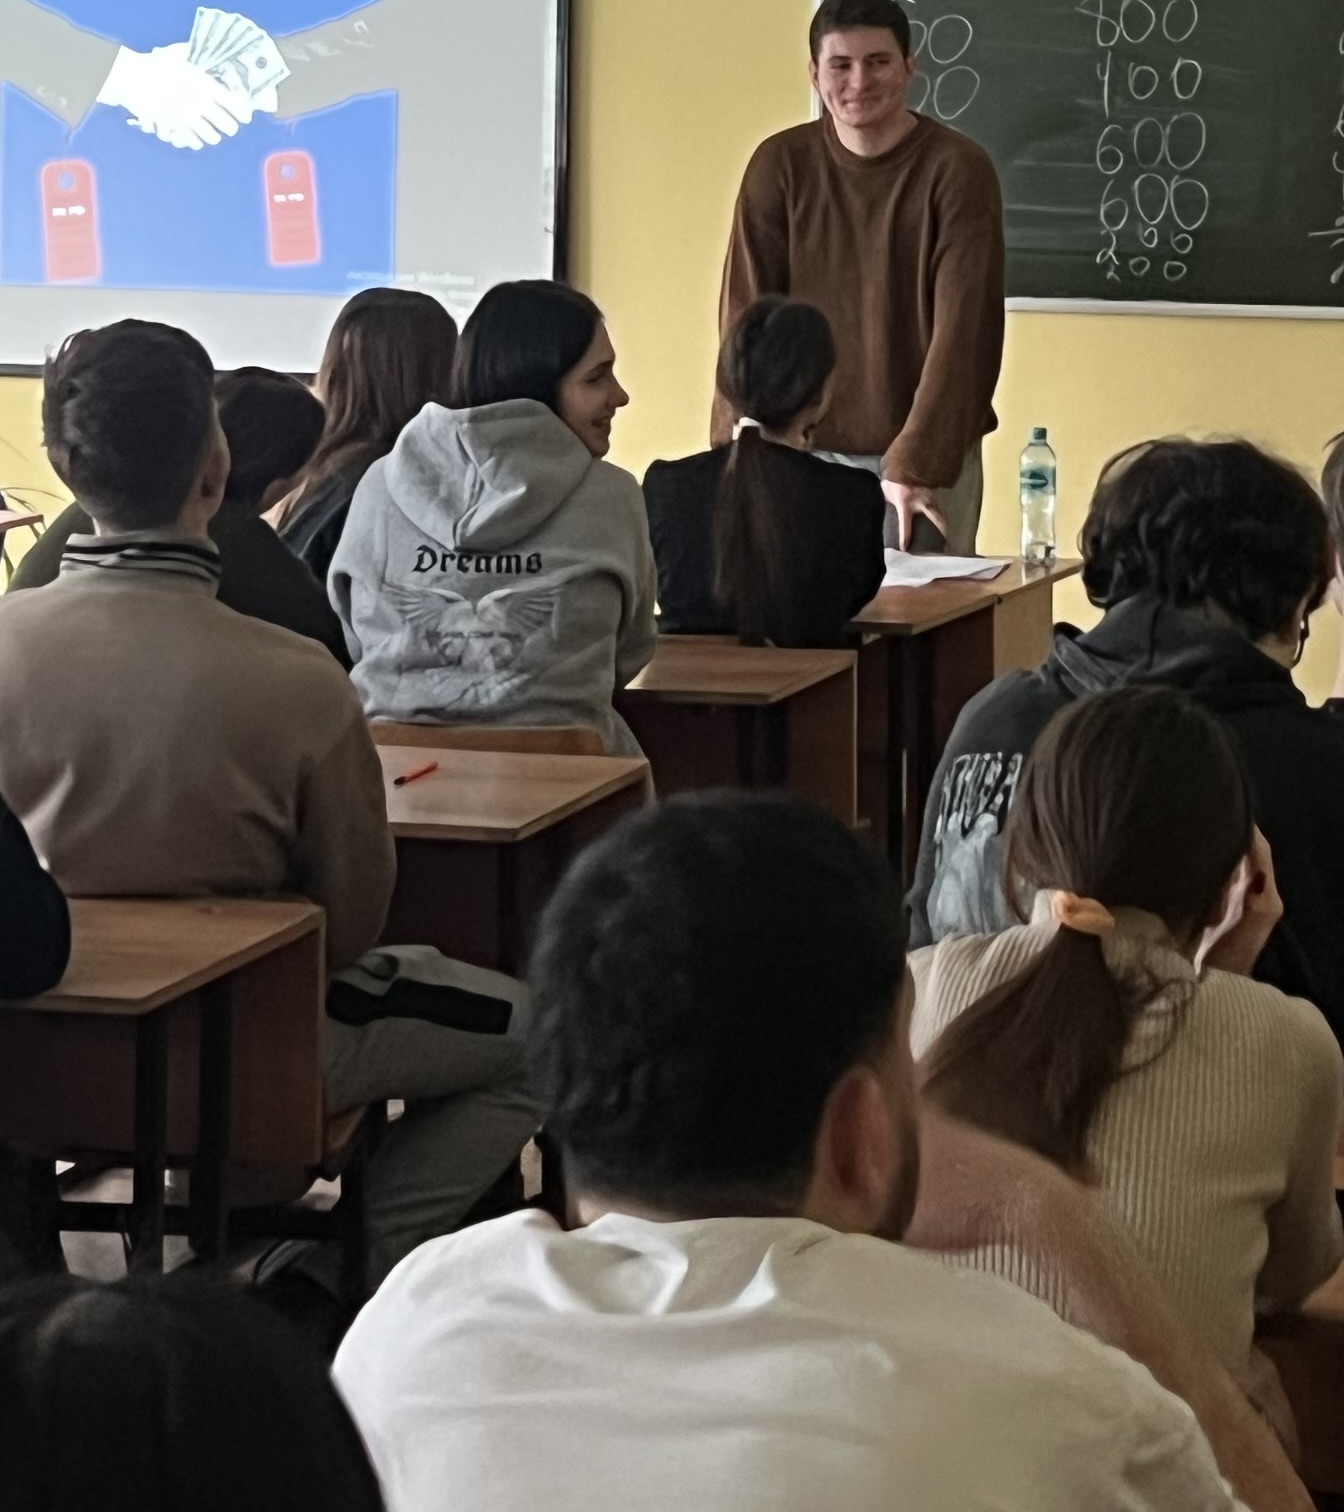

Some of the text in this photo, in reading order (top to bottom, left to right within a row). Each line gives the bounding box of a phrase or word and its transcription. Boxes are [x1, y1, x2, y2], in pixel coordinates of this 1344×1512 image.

[1096, 111, 1207, 175] 600
[1100, 170, 1209, 231] 600
[412, 543, 543, 575] Dreams
